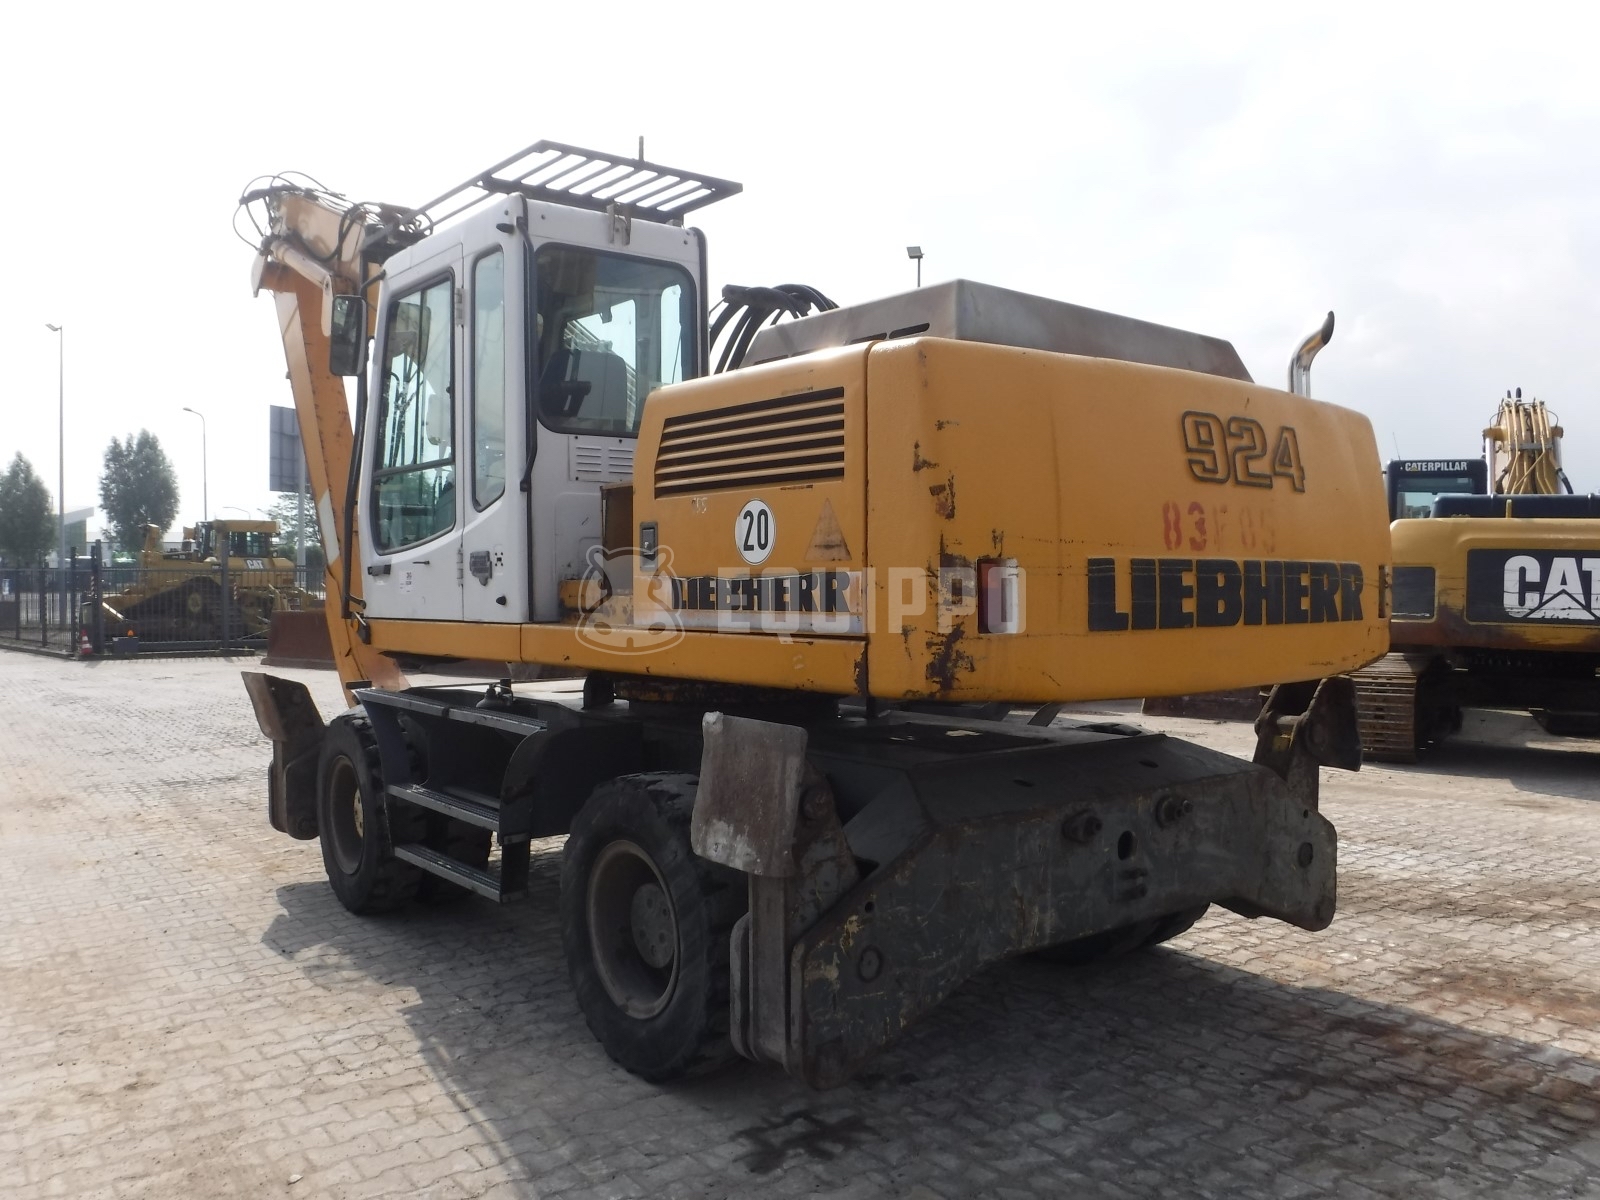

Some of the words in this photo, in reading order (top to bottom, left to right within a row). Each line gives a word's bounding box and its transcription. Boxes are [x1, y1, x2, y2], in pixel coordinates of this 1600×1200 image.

[1181, 410, 1306, 493] 924
[1404, 461, 1468, 472] CATERPILLAR
[743, 508, 769, 552] 20
[246, 559, 264, 569] CAT
[672, 572, 851, 613] LIEBHERR
[1088, 557, 1364, 632] LIEBHERR
